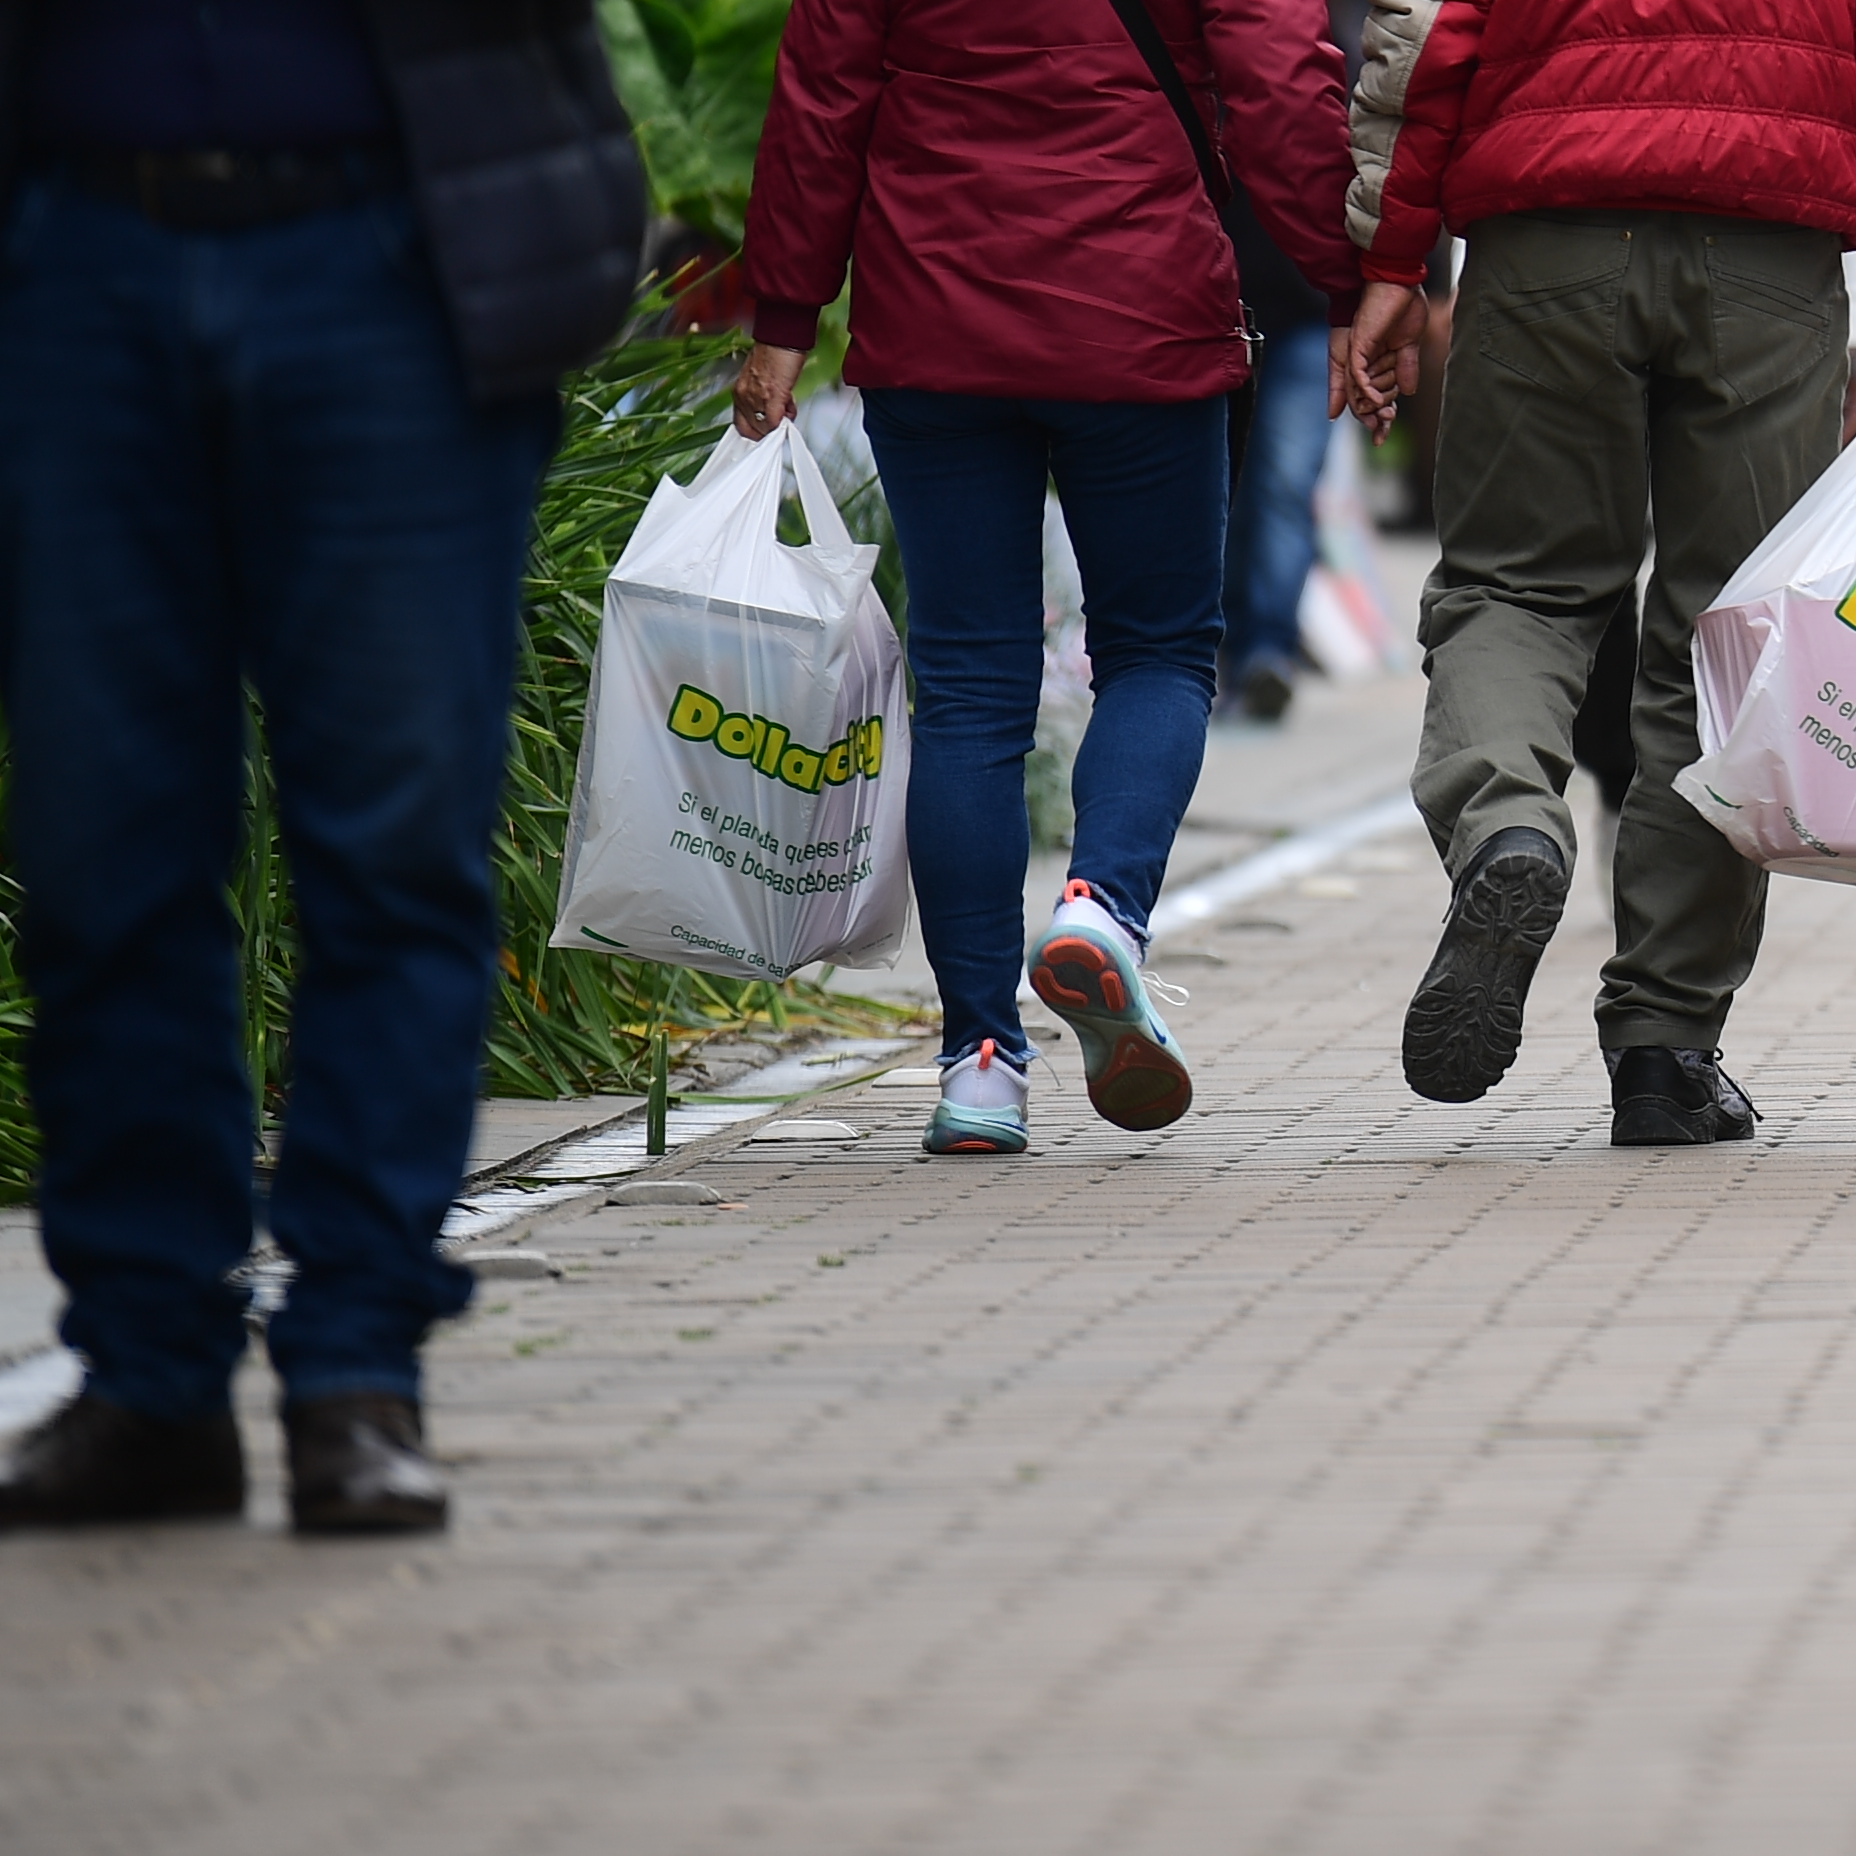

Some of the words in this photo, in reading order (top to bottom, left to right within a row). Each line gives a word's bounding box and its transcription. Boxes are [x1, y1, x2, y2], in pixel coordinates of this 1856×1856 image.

[1817, 681, 1842, 706] Si
[678, 792, 699, 815] Si
[700, 806, 719, 824] el
[669, 829, 736, 868] menos
[671, 925, 746, 959] Capacidad
[747, 953, 766, 967] de
